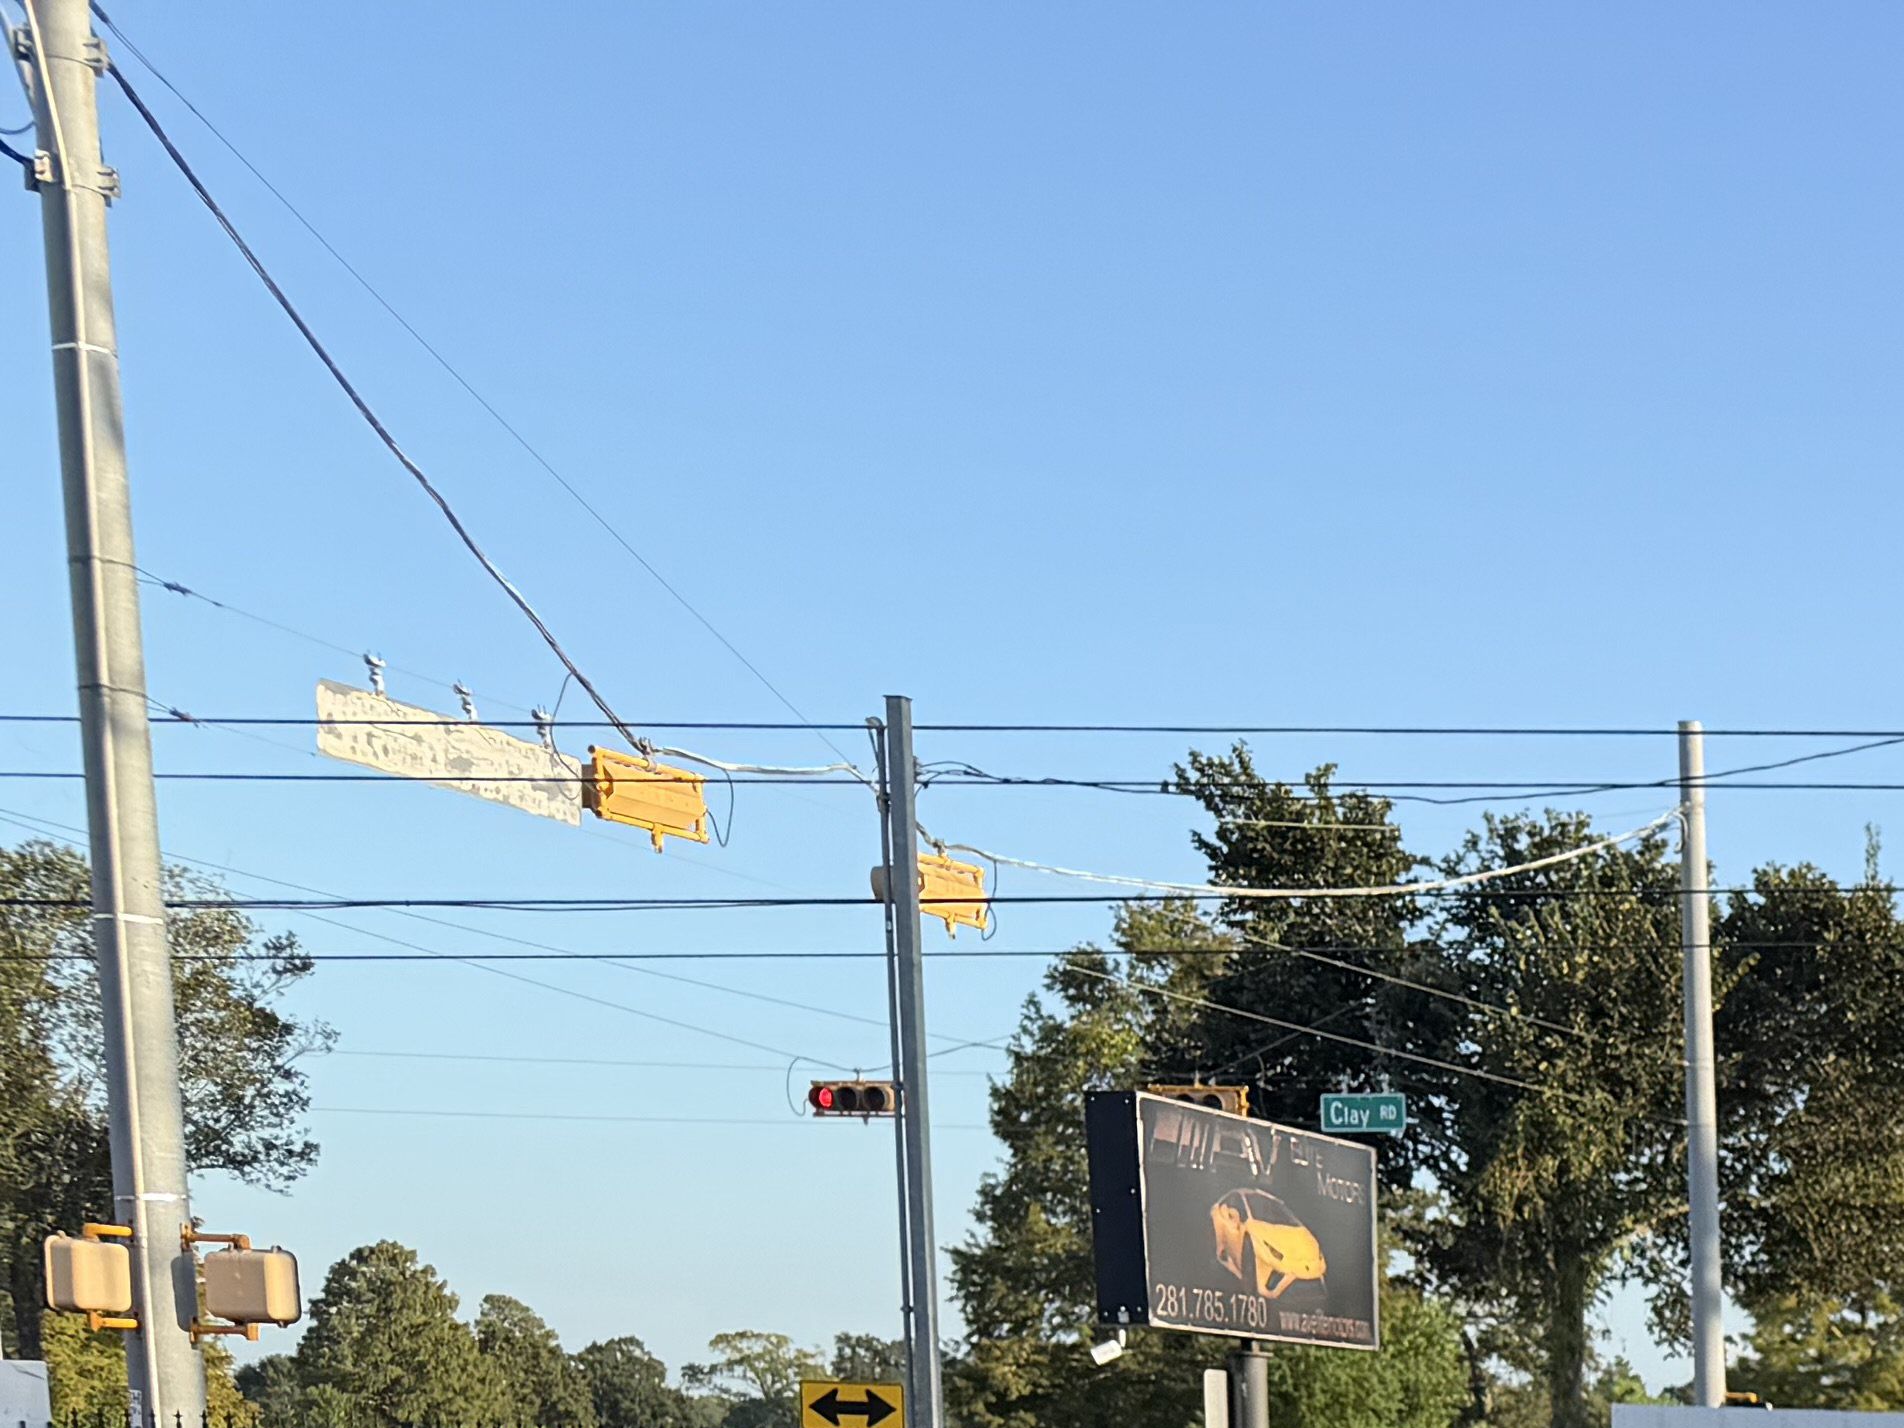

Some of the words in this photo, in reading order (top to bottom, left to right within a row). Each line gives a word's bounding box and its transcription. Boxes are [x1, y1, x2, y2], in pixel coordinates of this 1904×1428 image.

[1329, 1101, 1370, 1129] Clay
[1379, 1104, 1397, 1121] RD
[1155, 1283, 1268, 1329] 281.785.1780
